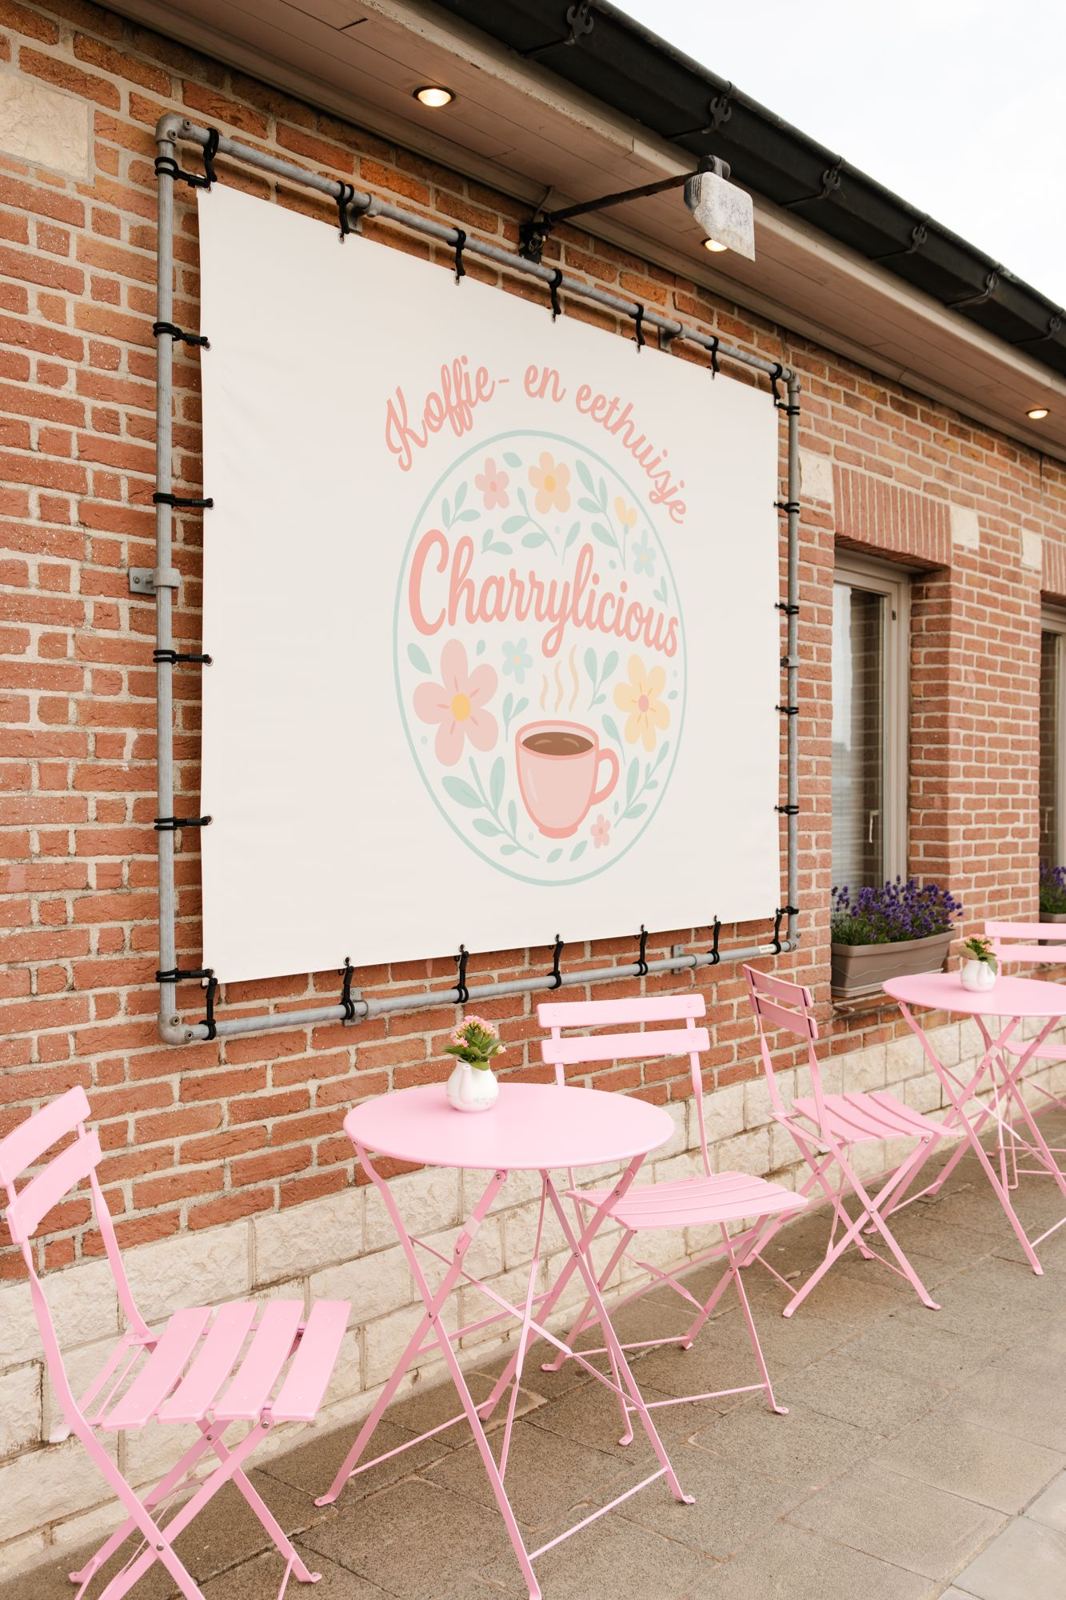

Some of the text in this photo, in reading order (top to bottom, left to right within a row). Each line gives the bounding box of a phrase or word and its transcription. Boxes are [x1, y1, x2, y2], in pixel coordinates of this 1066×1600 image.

[385, 355, 687, 524] Koffie- en eethuisje
[409, 529, 679, 658] Charrylicious
